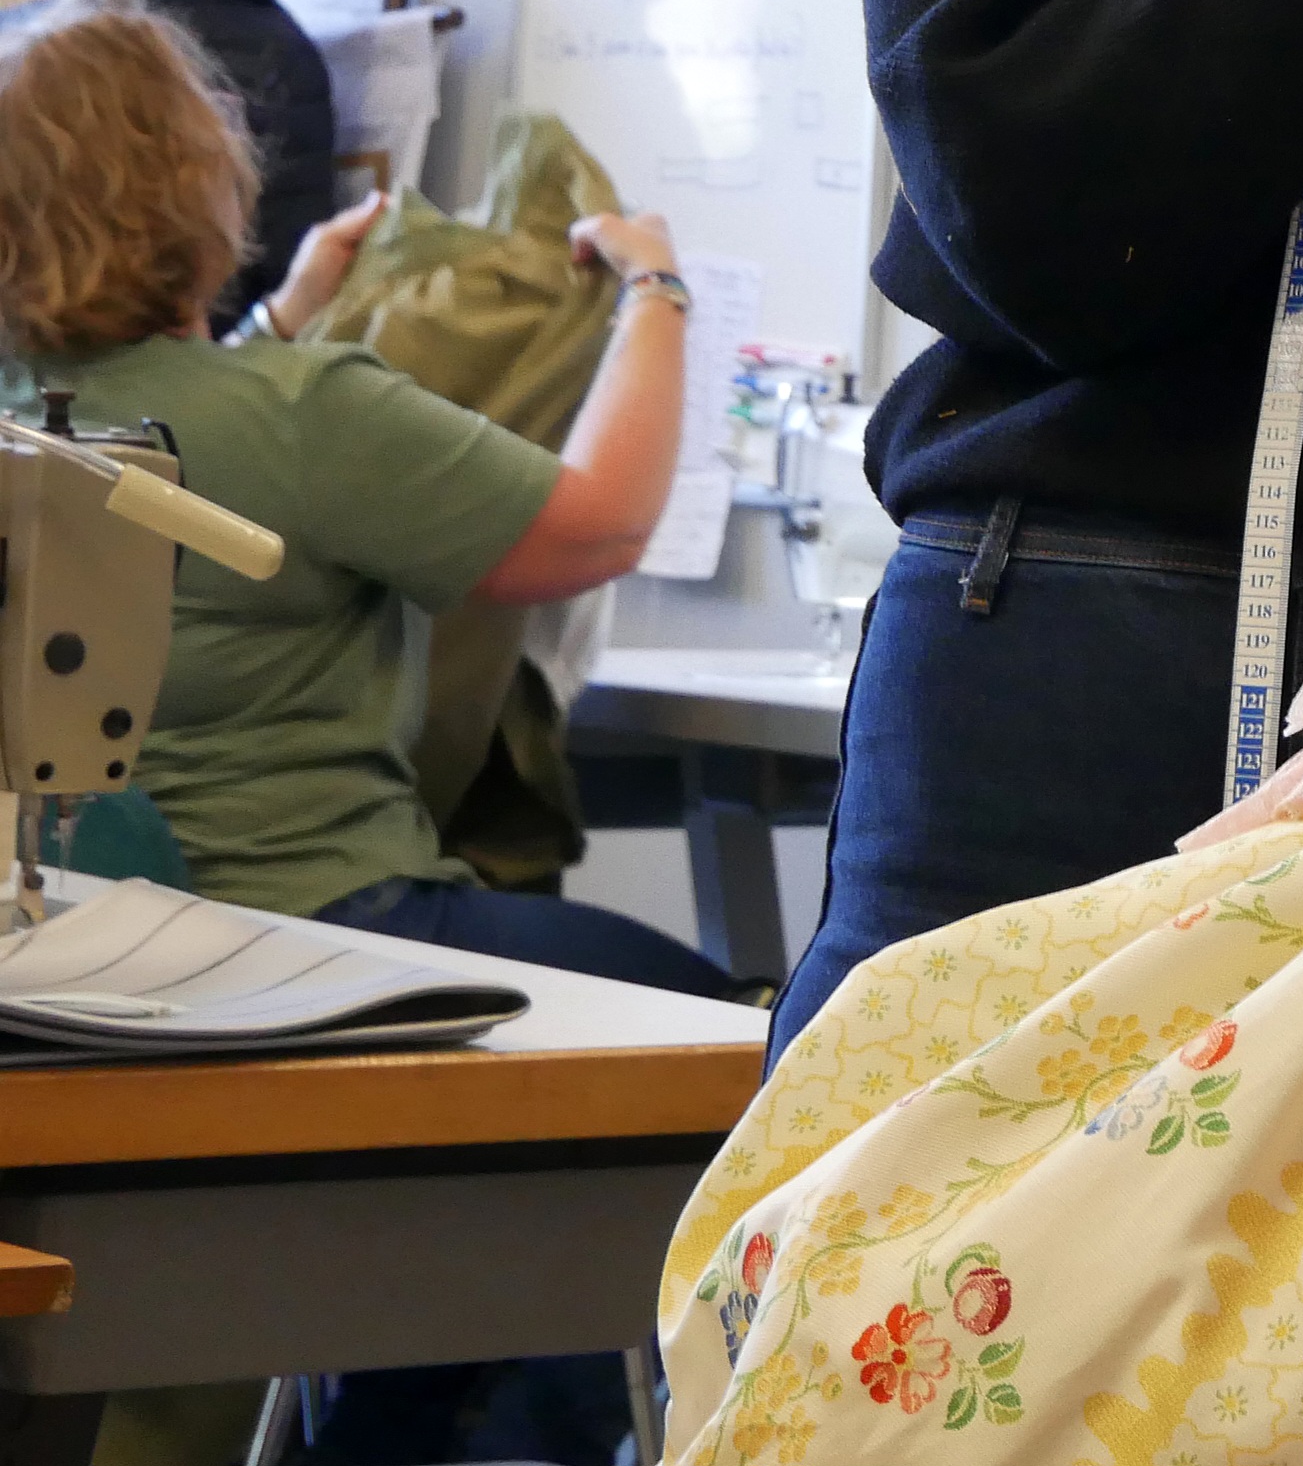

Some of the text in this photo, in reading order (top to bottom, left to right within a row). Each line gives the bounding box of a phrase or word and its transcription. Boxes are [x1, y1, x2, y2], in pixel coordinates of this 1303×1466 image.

[1262, 455, 1285, 470] 113
[1259, 485, 1282, 500] 114
[1256, 514, 1279, 530] 115
[1252, 544, 1276, 559] 116
[1250, 574, 1274, 589] 117
[1248, 603, 1272, 619] 118
[1245, 634, 1270, 649] 119
[1243, 663, 1268, 679] 120
[1241, 693, 1265, 709] 121
[1239, 723, 1263, 739] 122
[1237, 753, 1261, 770] 123
